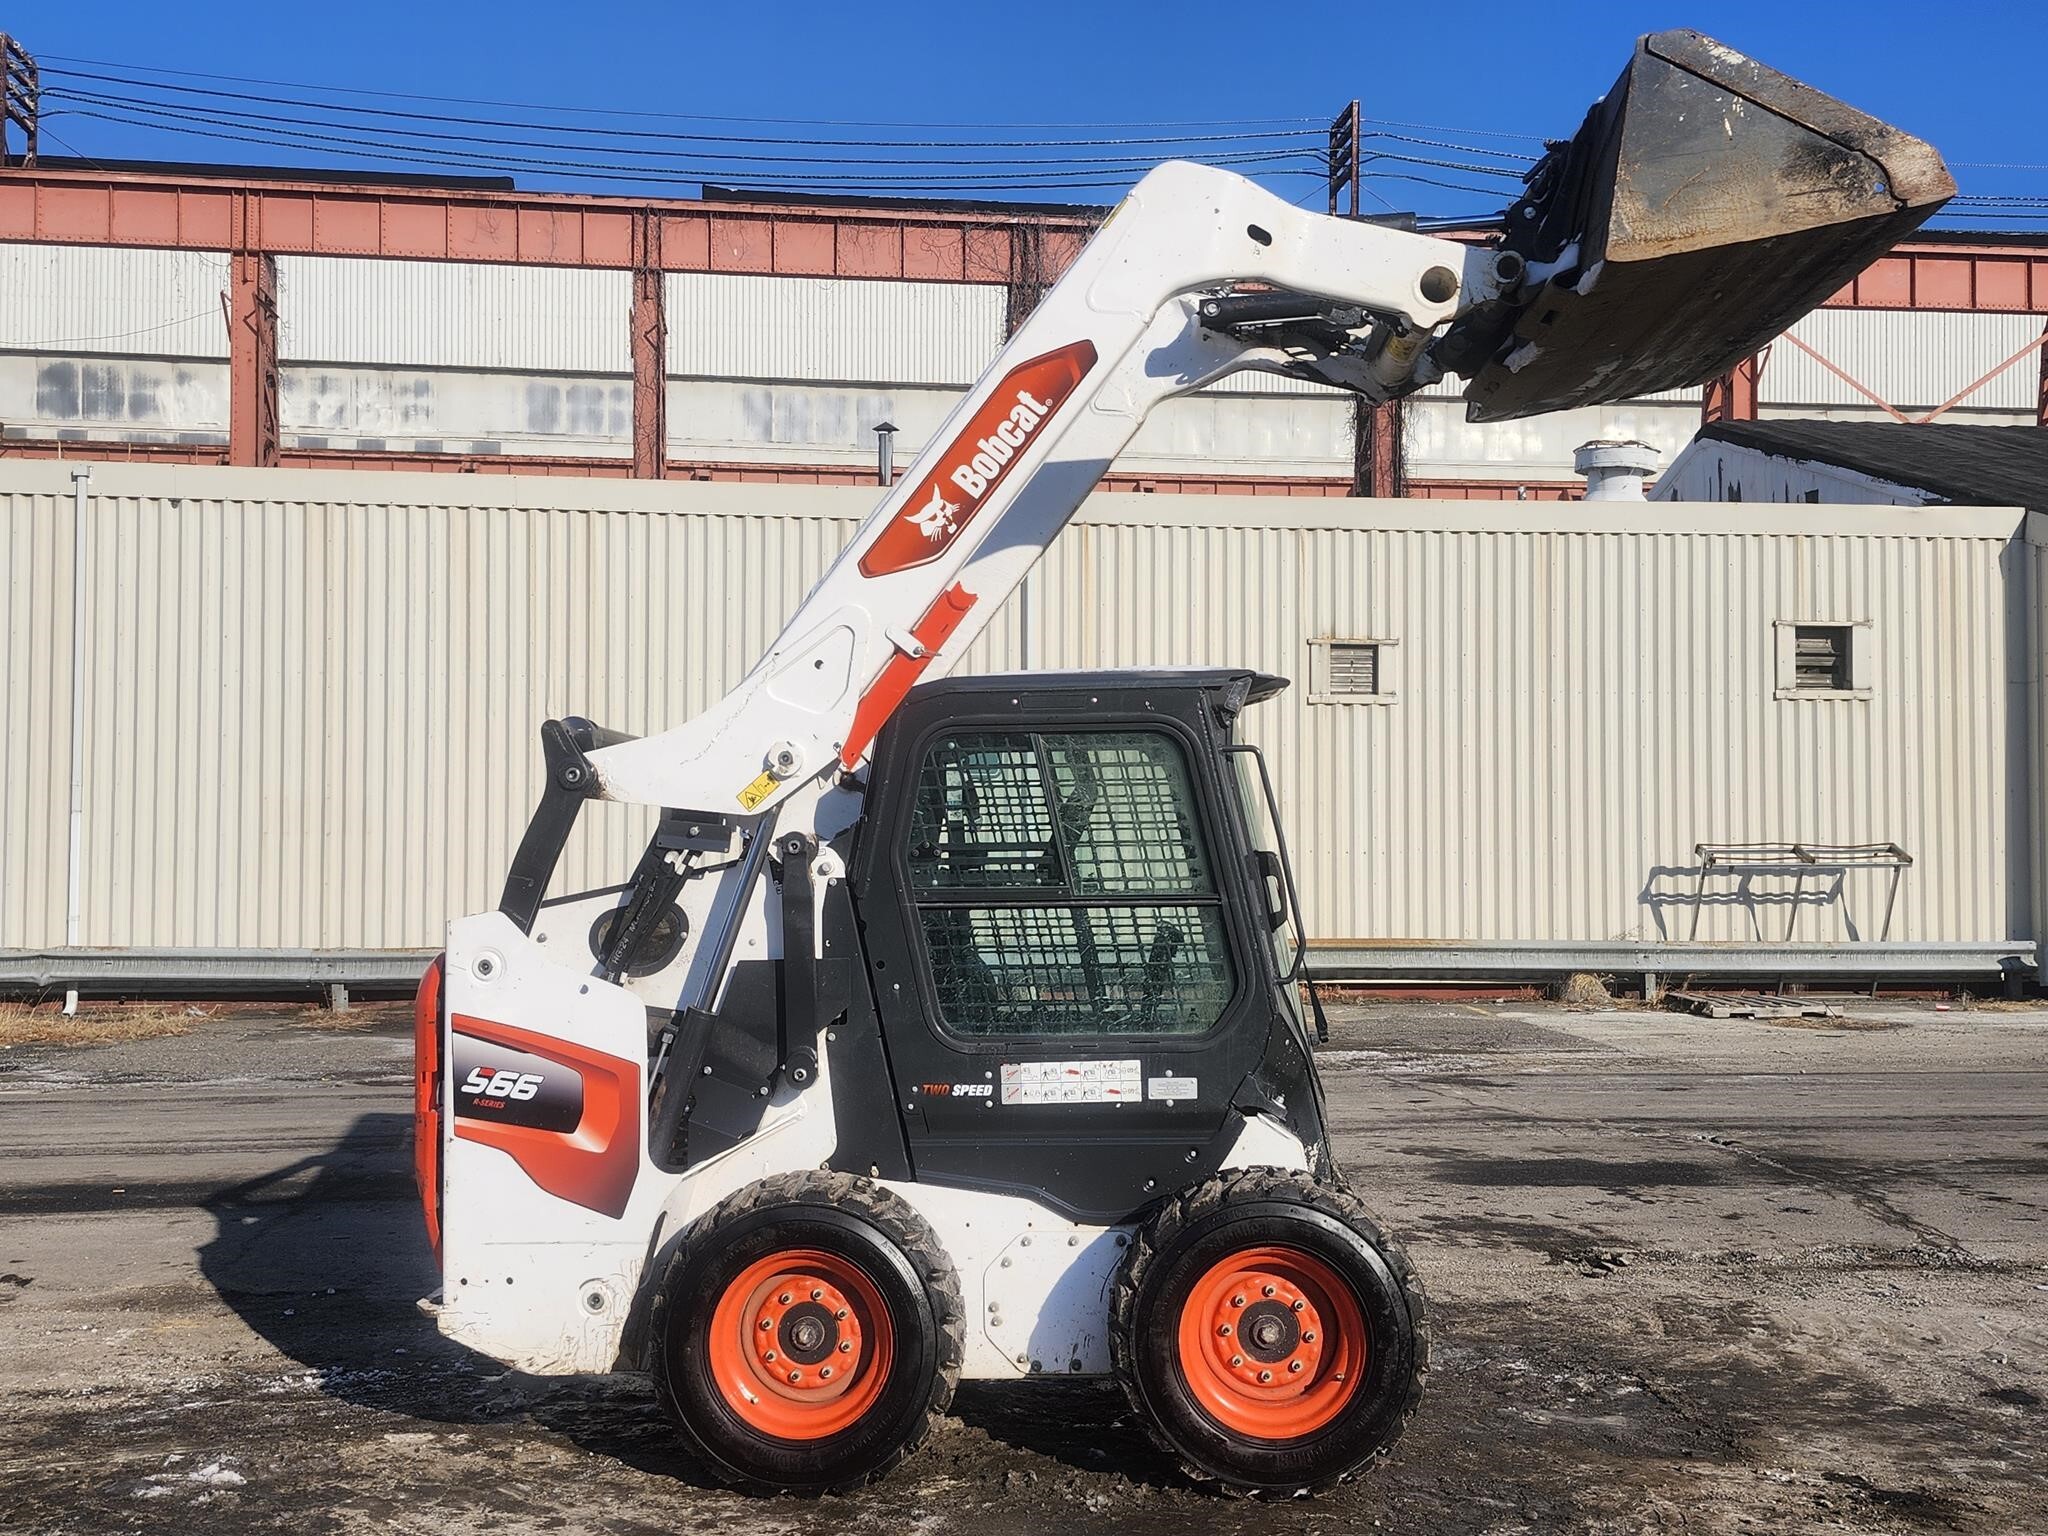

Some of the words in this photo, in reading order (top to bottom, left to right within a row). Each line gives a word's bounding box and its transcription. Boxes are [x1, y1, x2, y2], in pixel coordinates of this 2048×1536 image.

[950, 390, 1049, 499] Bobcat
[461, 1066, 545, 1101] S66
[923, 1084, 950, 1096] TWO
[951, 1084, 993, 1097] SPEED
[472, 1098, 505, 1109] R-SERIES
